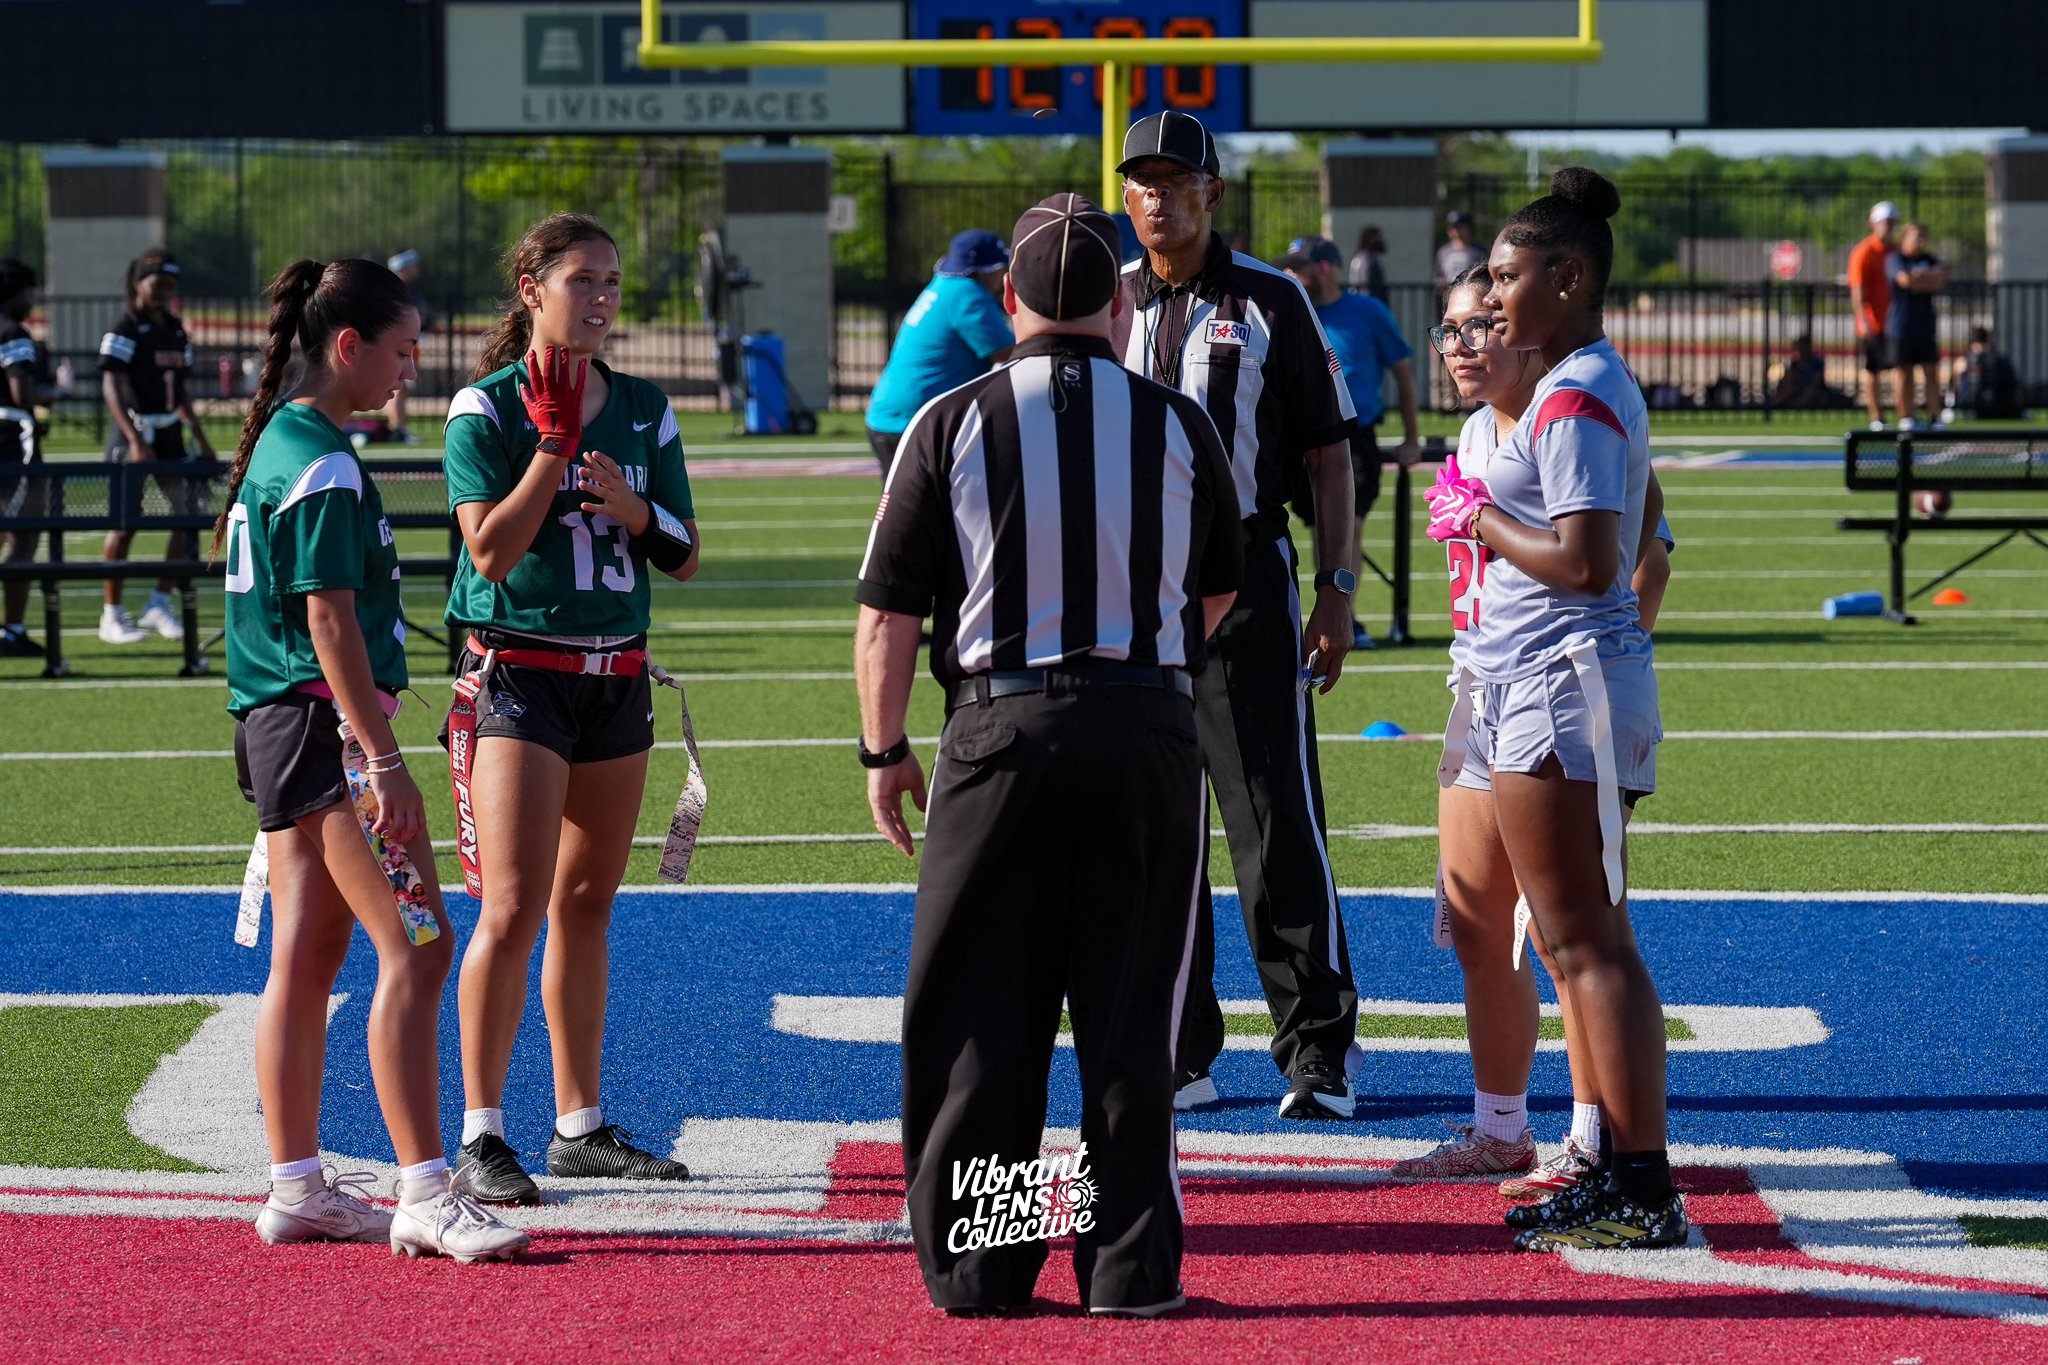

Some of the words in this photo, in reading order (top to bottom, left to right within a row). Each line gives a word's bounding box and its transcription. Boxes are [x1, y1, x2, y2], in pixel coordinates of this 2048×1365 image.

[522, 93, 664, 122] LIVING
[683, 91, 830, 122] SPACES
[559, 511, 636, 593] 13
[451, 730, 462, 771] MESS
[454, 780, 478, 866] FURY
